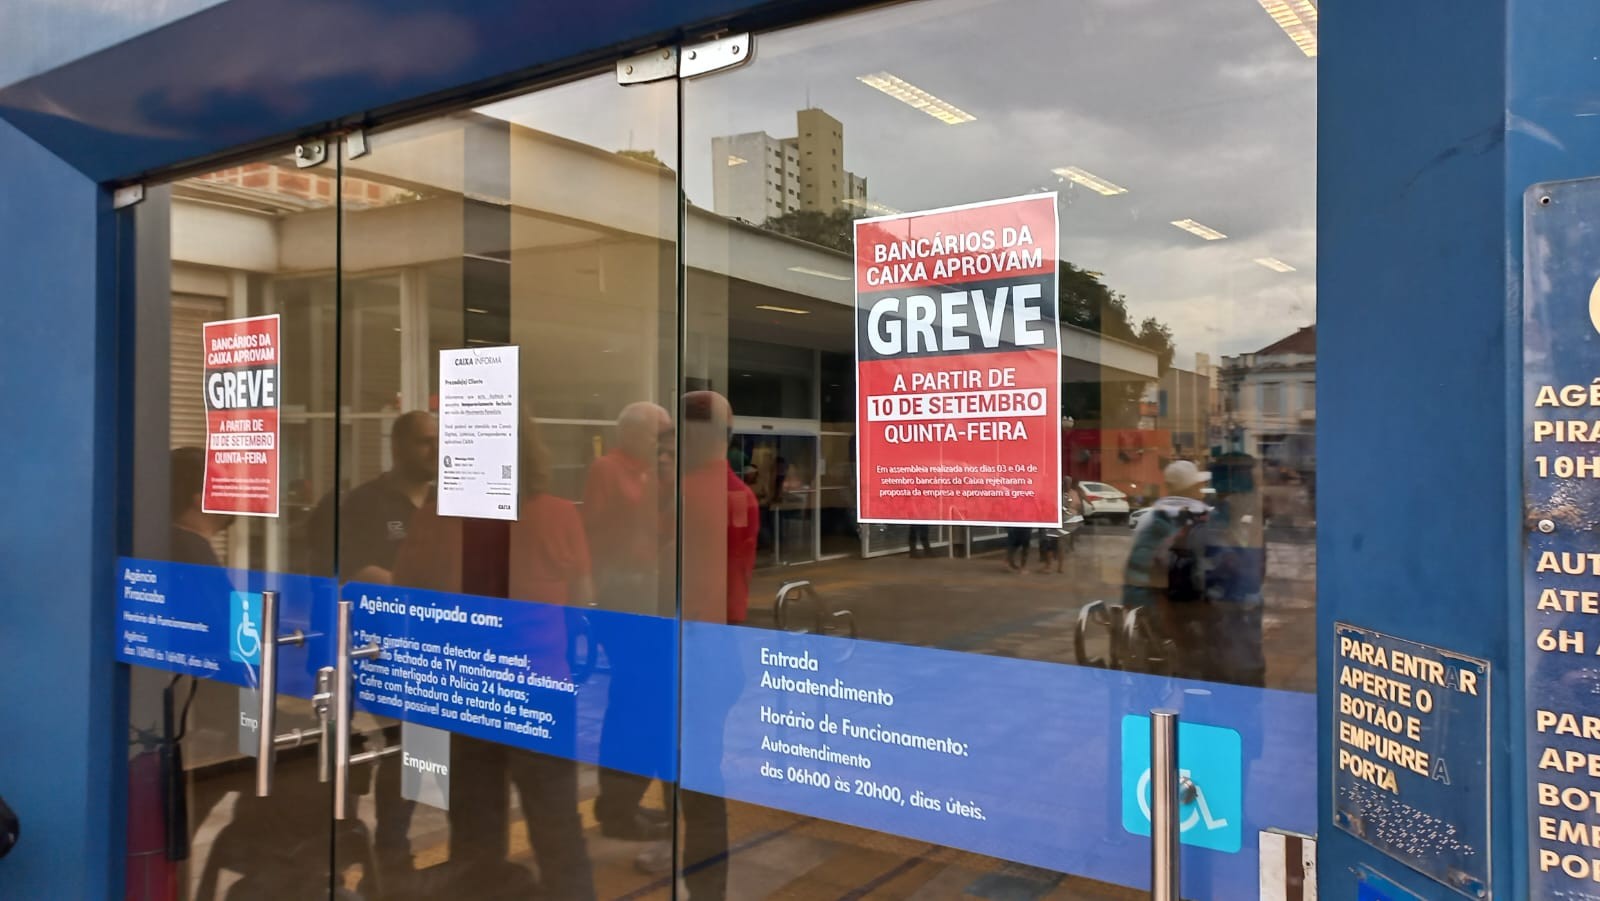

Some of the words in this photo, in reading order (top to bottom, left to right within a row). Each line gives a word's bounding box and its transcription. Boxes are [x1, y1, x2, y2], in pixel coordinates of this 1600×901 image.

[874, 229, 996, 263] BANCÁRIOS
[1002, 225, 1033, 248] DA
[866, 261, 928, 286] CAIXA
[933, 248, 1042, 280] APROVAM
[867, 283, 1045, 356] GREVE
[208, 351, 232, 366] CAIXA
[233, 347, 274, 363] APROVAM
[212, 333, 258, 351] BANCÁRIOS
[259, 333, 271, 347] DA
[454, 358, 474, 366] CAIXA
[475, 356, 502, 365] INFORMA
[208, 369, 274, 409] GREVE
[893, 374, 907, 392] A
[911, 370, 982, 391] PARTIR
[988, 367, 1016, 387] DE
[1535, 376, 1600, 407] AGÊ
[872, 398, 893, 416] 10
[900, 396, 923, 415] DE
[928, 391, 1042, 414] SETEMBRO
[213, 435, 220, 447] 10
[221, 435, 229, 446] DE
[231, 434, 273, 447] SETEMBRO
[220, 420, 225, 432] A
[226, 419, 251, 432] PARTIR
[252, 419, 264, 432] DE
[884, 421, 1028, 444] QUINTA-FEIRA
[214, 452, 267, 464] QUINTA-FEIRA
[876, 465, 888, 473] Em
[889, 464, 929, 473] assembleia
[929, 464, 963, 473] realizada
[980, 464, 995, 473] dias
[996, 464, 1007, 473] 03
[1015, 464, 1025, 473] 04
[1027, 464, 1038, 473] de
[1535, 455, 1600, 478] 10H
[879, 489, 911, 498] proposta
[912, 487, 922, 496] da
[922, 489, 955, 498] empresa
[962, 489, 1004, 498] aprovaram
[1011, 490, 1035, 499] greve
[881, 477, 915, 485] setembro
[915, 476, 951, 485] bancários
[952, 476, 962, 485] da
[963, 476, 985, 485] Caixa
[985, 476, 1026, 486] rejeitaram
[124, 568, 157, 584] Agência
[1536, 551, 1600, 576] AUT
[359, 595, 405, 615] Agência
[409, 602, 468, 624] equipada
[470, 611, 503, 629] com:
[1537, 588, 1599, 614] ATE
[360, 629, 381, 644] Porta
[382, 633, 420, 650] giratória
[421, 642, 441, 654] com
[443, 645, 481, 661] detector
[483, 648, 497, 663] de
[498, 654, 531, 671] metal;
[1536, 629, 1584, 654] 6H
[393, 649, 429, 667] fechado
[430, 656, 442, 669] de
[445, 658, 457, 672] TV
[459, 663, 515, 684] monitorado
[517, 672, 525, 684] à
[527, 672, 580, 696] distância;
[761, 647, 818, 672] Entrada
[1340, 636, 1388, 670] PARA
[1391, 650, 1478, 696] ENTRAR
[359, 660, 390, 675] Alarme
[391, 664, 438, 685] interligado
[449, 674, 479, 692] Polícia
[481, 680, 495, 695] 24
[497, 683, 530, 703] horas;
[760, 671, 893, 706] Autoatendimento
[1340, 665, 1411, 708] APERTE
[1415, 689, 1433, 713] O
[359, 673, 383, 689] Cofre
[384, 681, 402, 692] com
[404, 681, 449, 701] fechadura
[451, 691, 463, 705] de
[466, 695, 501, 713] retardo
[503, 700, 517, 715] de
[519, 705, 556, 726] tempo,
[359, 689, 376, 701] não
[377, 693, 403, 707] sendo
[404, 701, 439, 715] possível
[441, 708, 458, 719] sua
[460, 710, 502, 729] abertura
[503, 716, 553, 739] imediata.
[760, 705, 815, 730] Horário
[819, 714, 838, 734] de
[842, 719, 969, 757] Funcionamento:
[1407, 715, 1421, 742] E
[1537, 709, 1600, 740] PAR
[761, 736, 871, 769] Autoatendimento
[1340, 720, 1429, 777] EMPURRE
[1538, 747, 1600, 777] APE
[403, 752, 448, 776] Empurre
[1340, 748, 1399, 795] PORTA
[760, 762, 783, 780] das
[787, 766, 830, 789] 06h00
[834, 776, 850, 793] às
[854, 780, 906, 807] 20h00,
[910, 791, 941, 811] dias
[946, 797, 987, 821] úteis.
